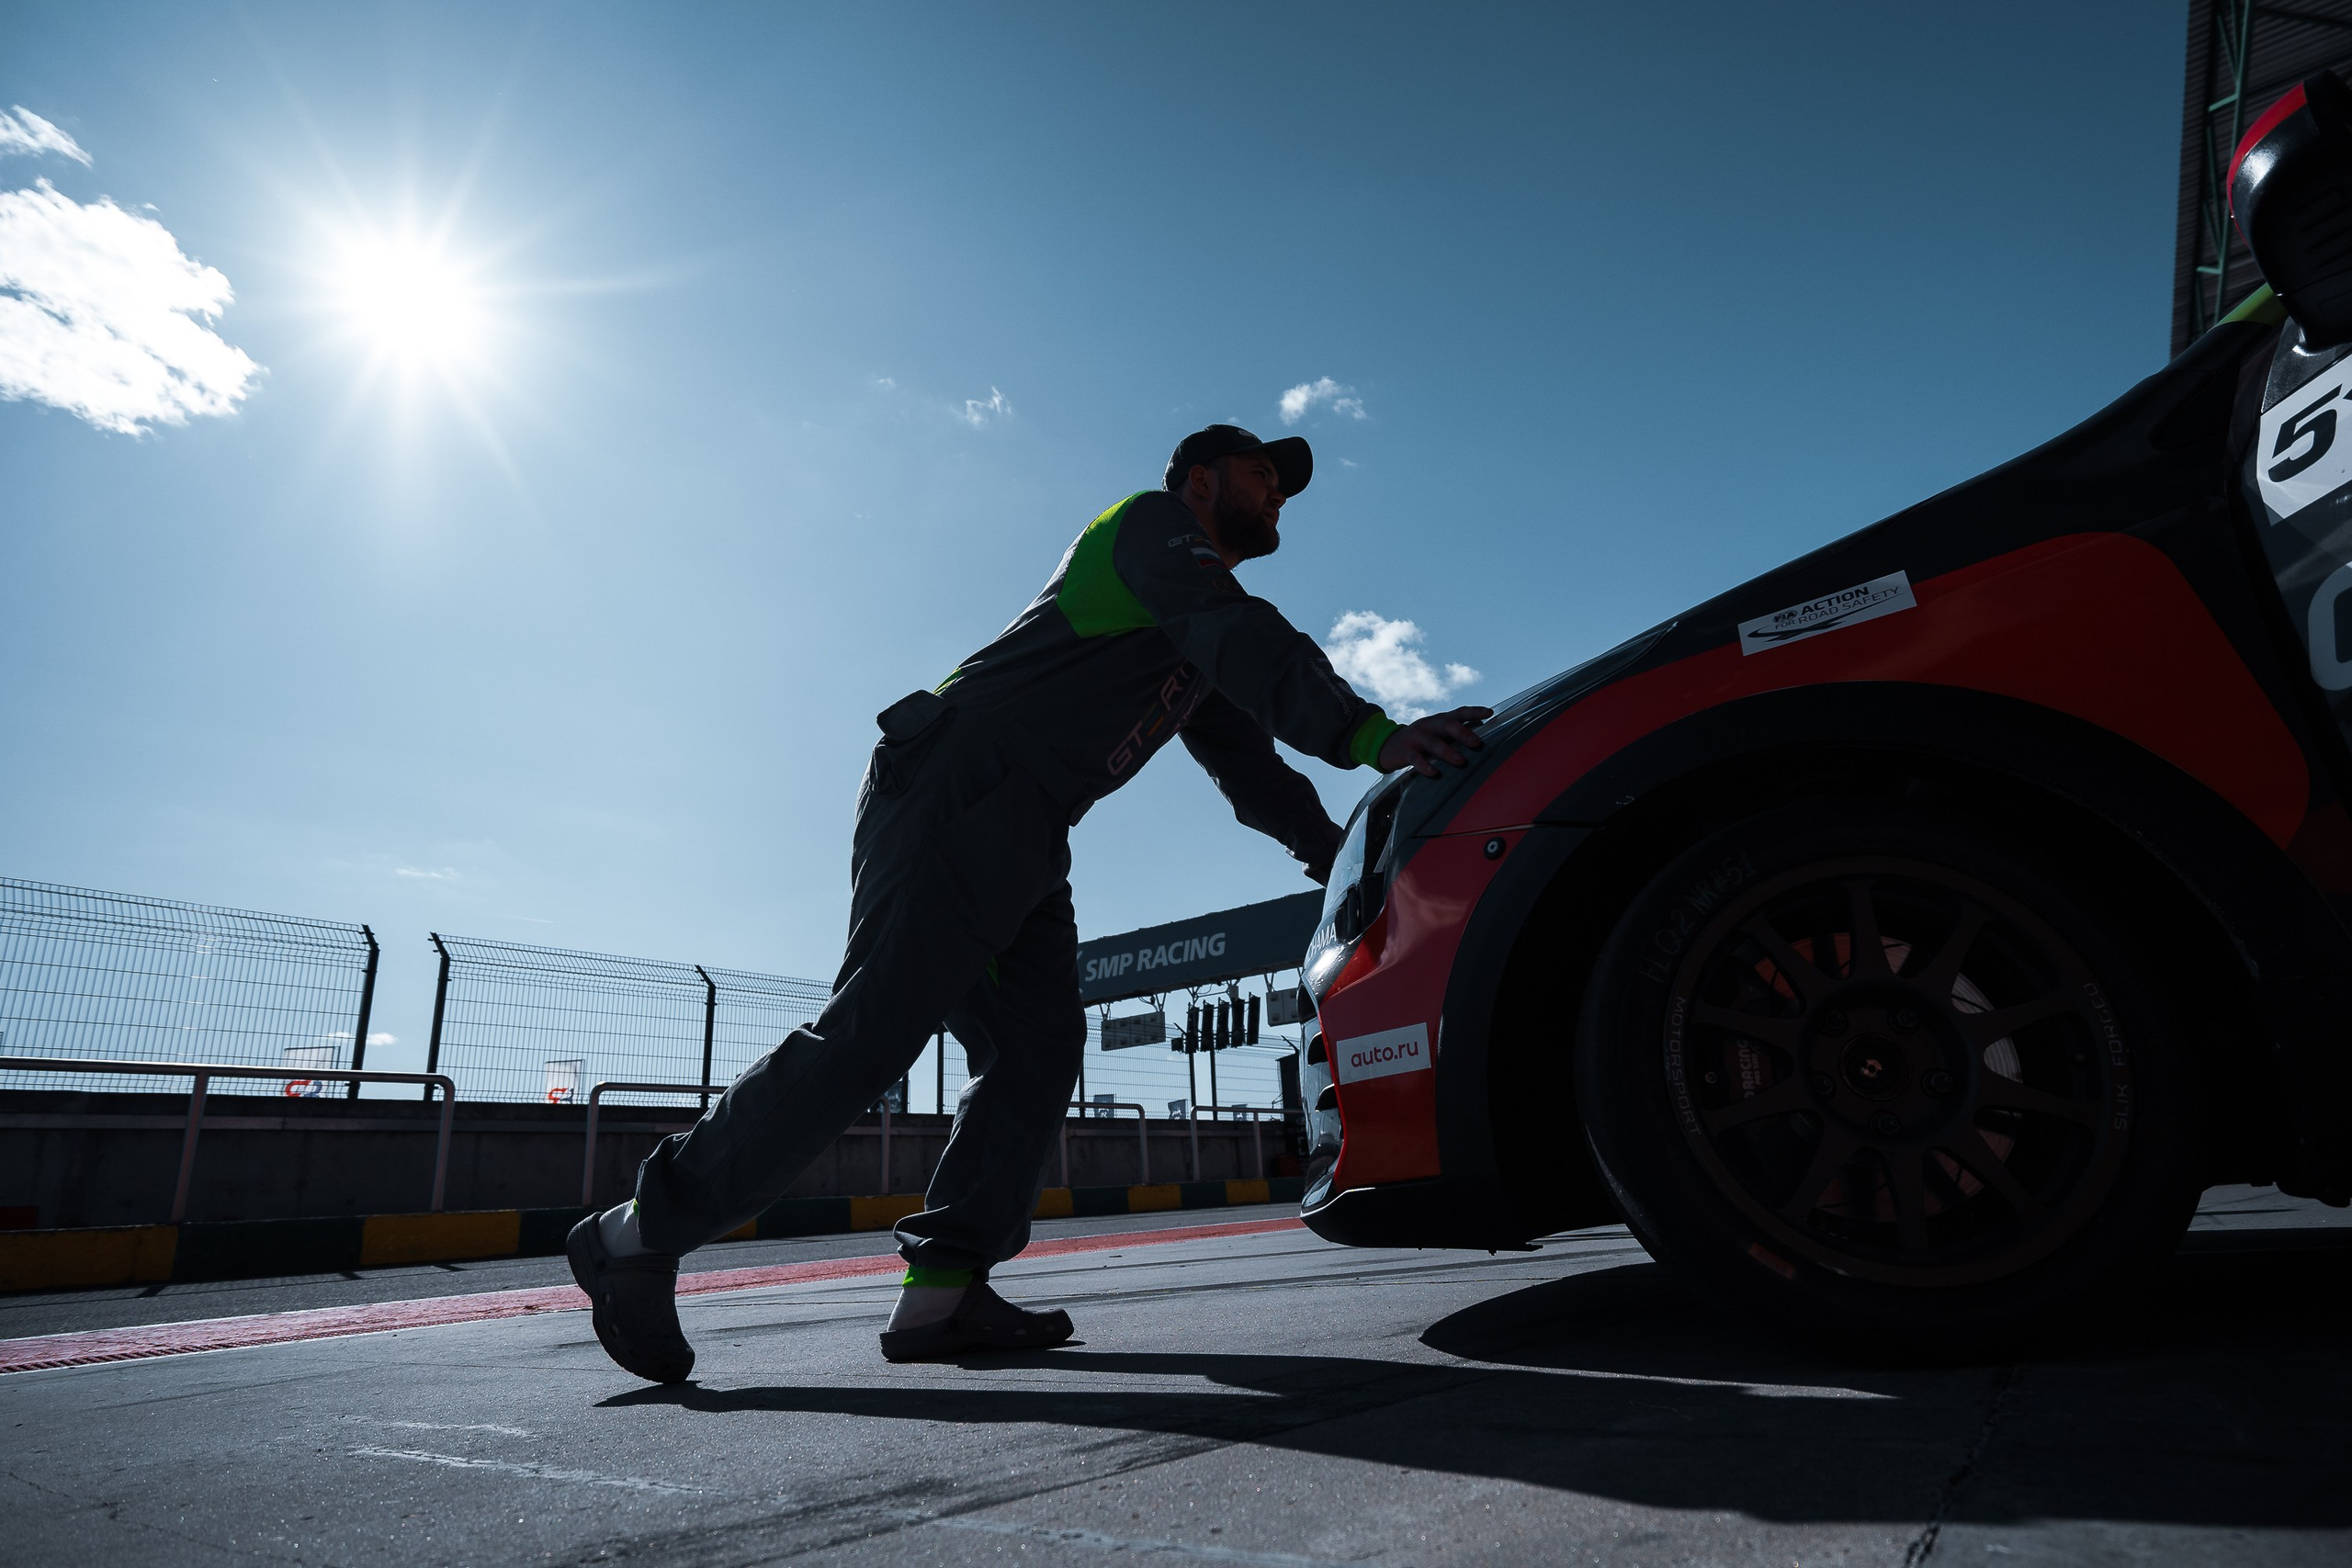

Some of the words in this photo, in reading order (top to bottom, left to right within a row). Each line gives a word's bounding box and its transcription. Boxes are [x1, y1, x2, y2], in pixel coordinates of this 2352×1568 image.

[2267, 383, 2352, 483] 5
[1772, 609, 1798, 624] FIA
[1801, 586, 1870, 615] ACTION
[1775, 619, 1795, 630] FOR
[1798, 607, 1838, 625] ROAD
[1842, 586, 1900, 610] SAFETY
[1085, 952, 1135, 982] SMP
[1136, 931, 1227, 972] RACING
[1351, 1041, 1419, 1067] auto.ru
[1669, 996, 1702, 1135] MOTORSPORT
